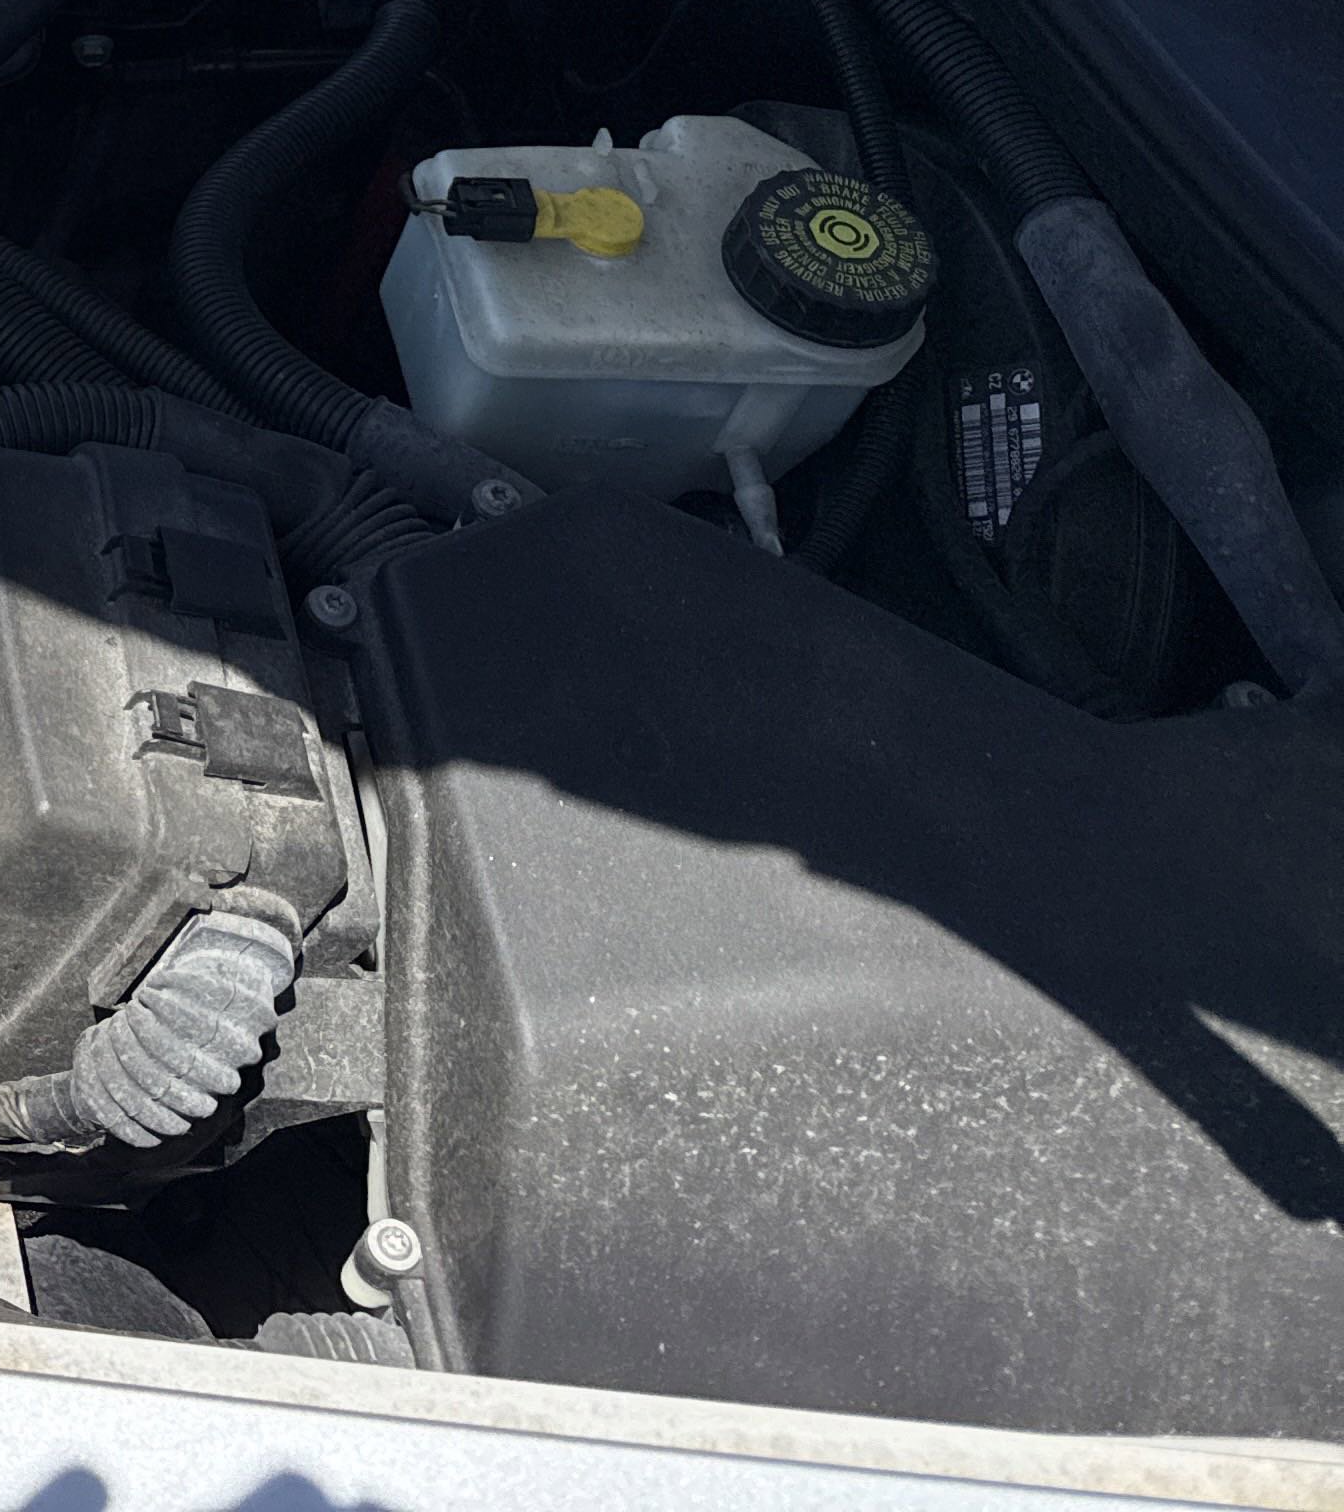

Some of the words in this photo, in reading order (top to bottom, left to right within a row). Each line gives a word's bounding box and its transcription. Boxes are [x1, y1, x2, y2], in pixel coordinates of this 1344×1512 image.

[775, 183, 801, 201] DOT
[802, 171, 869, 194] WARNING
[820, 182, 872, 206] BRAKE
[759, 195, 781, 220] ONLY
[811, 195, 867, 216] ORIGINAL
[876, 191, 916, 224] CLEAN
[875, 204, 908, 235] FLUID
[759, 223, 780, 246] USE
[775, 216, 828, 276] CONTAINER
[773, 249, 844, 296] REMOVING
[835, 272, 888, 289] SEALED
[858, 283, 908, 302] BEFORE
